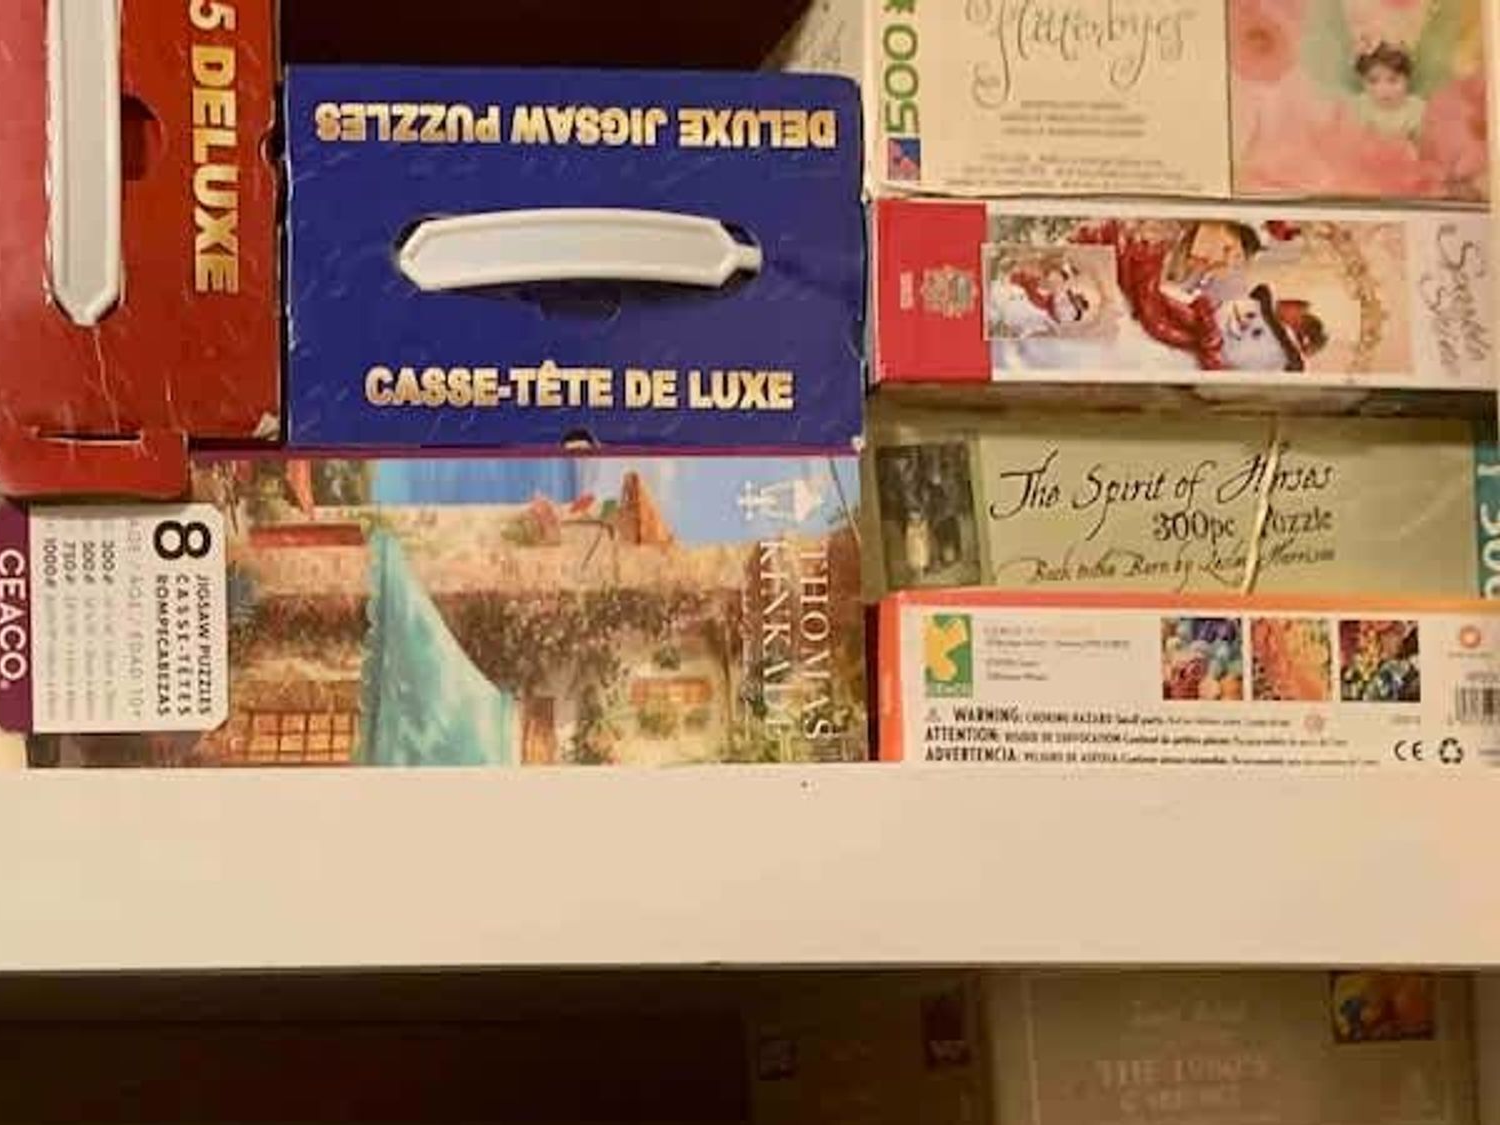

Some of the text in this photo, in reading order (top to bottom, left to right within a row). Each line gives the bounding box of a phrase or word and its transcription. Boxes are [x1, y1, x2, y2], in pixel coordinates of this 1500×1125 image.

[314, 102, 838, 148] DELUXE JIGSAW PUZZLES
[883, 23, 919, 136] 500
[190, 46, 240, 294] DELUXE
[364, 360, 795, 410] CASSE-TÊTE DE LUXE
[153, 520, 212, 561] 8
[990, 450, 1333, 541] The Spirit of Hrses
[1152, 511, 1236, 545] 300pc
[155, 573, 172, 717] ROMPECABEZAS
[196, 573, 212, 716] JIGSAW PUZZLES
